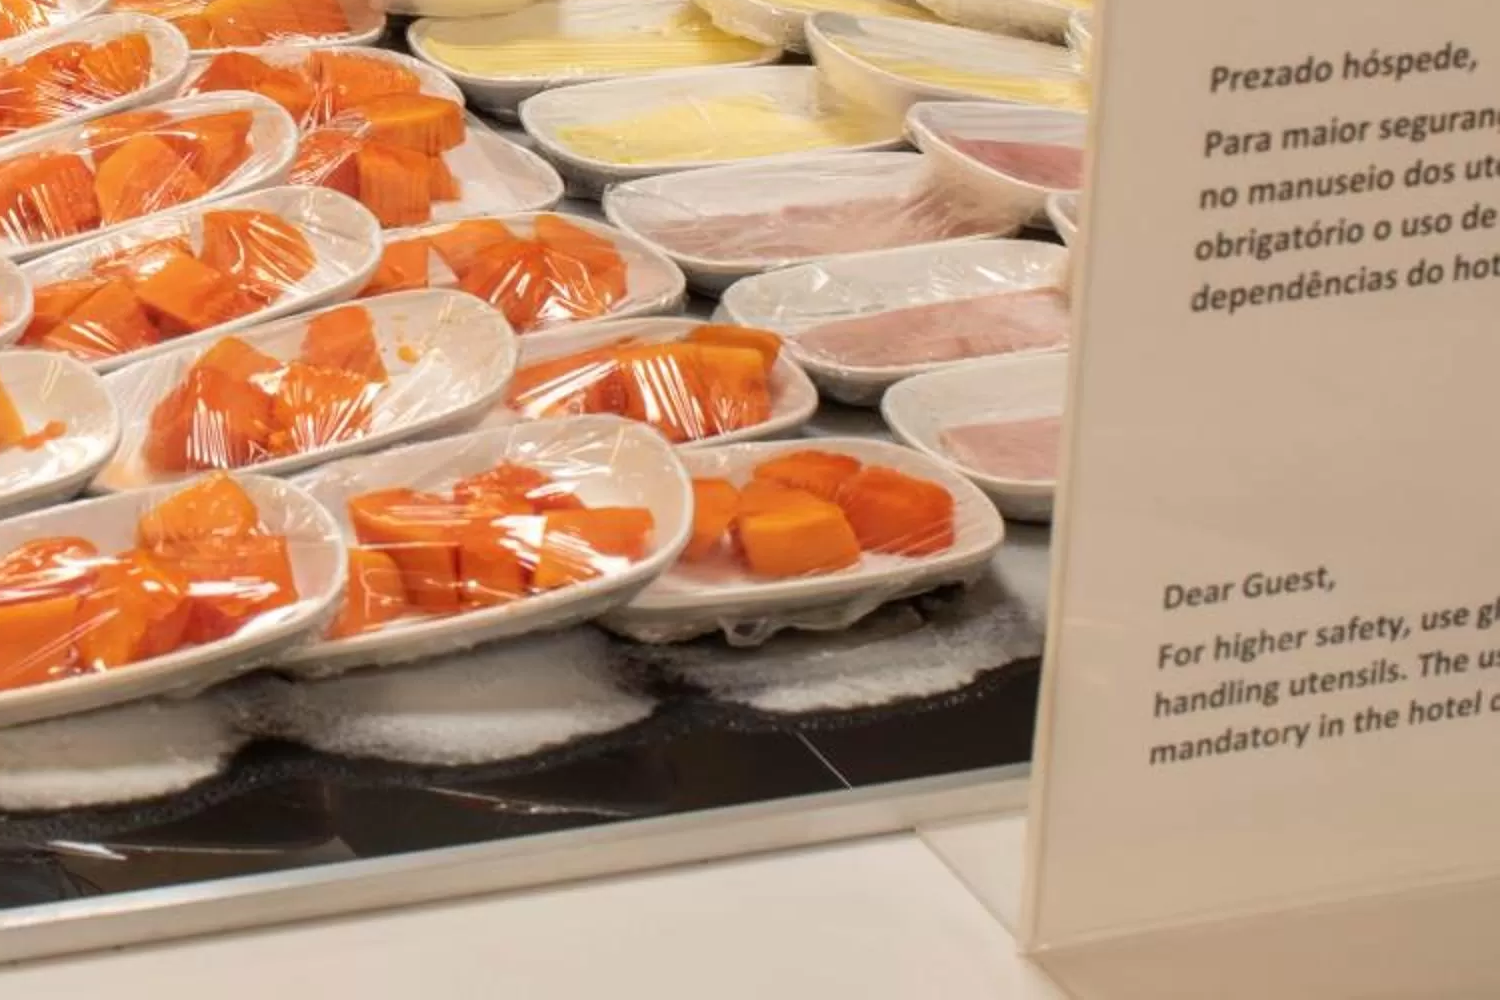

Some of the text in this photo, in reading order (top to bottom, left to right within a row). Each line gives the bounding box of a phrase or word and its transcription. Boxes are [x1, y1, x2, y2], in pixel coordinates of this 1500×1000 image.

[1209, 40, 1479, 93] Prezado hóspede,
[1204, 106, 1500, 158] Para maior seguran
[1199, 185, 1239, 210] no
[1247, 163, 1395, 205] manuseio
[1403, 159, 1456, 188] dos
[1195, 202, 1498, 261] obrigatório o uso de
[1190, 265, 1397, 315] dependências
[1406, 257, 1444, 288] do
[1162, 565, 1336, 611] Dear Guest,
[1157, 642, 1205, 669] For
[1213, 628, 1307, 663] higher
[1315, 615, 1411, 647] safety,
[1421, 606, 1470, 632] use
[1153, 678, 1280, 718] handling
[1288, 658, 1408, 698] utensils.
[1417, 649, 1470, 678] The
[1149, 721, 1311, 766] mandatory
[1318, 713, 1345, 739] in
[1353, 705, 1399, 734] the
[1407, 688, 1483, 726] hotel
